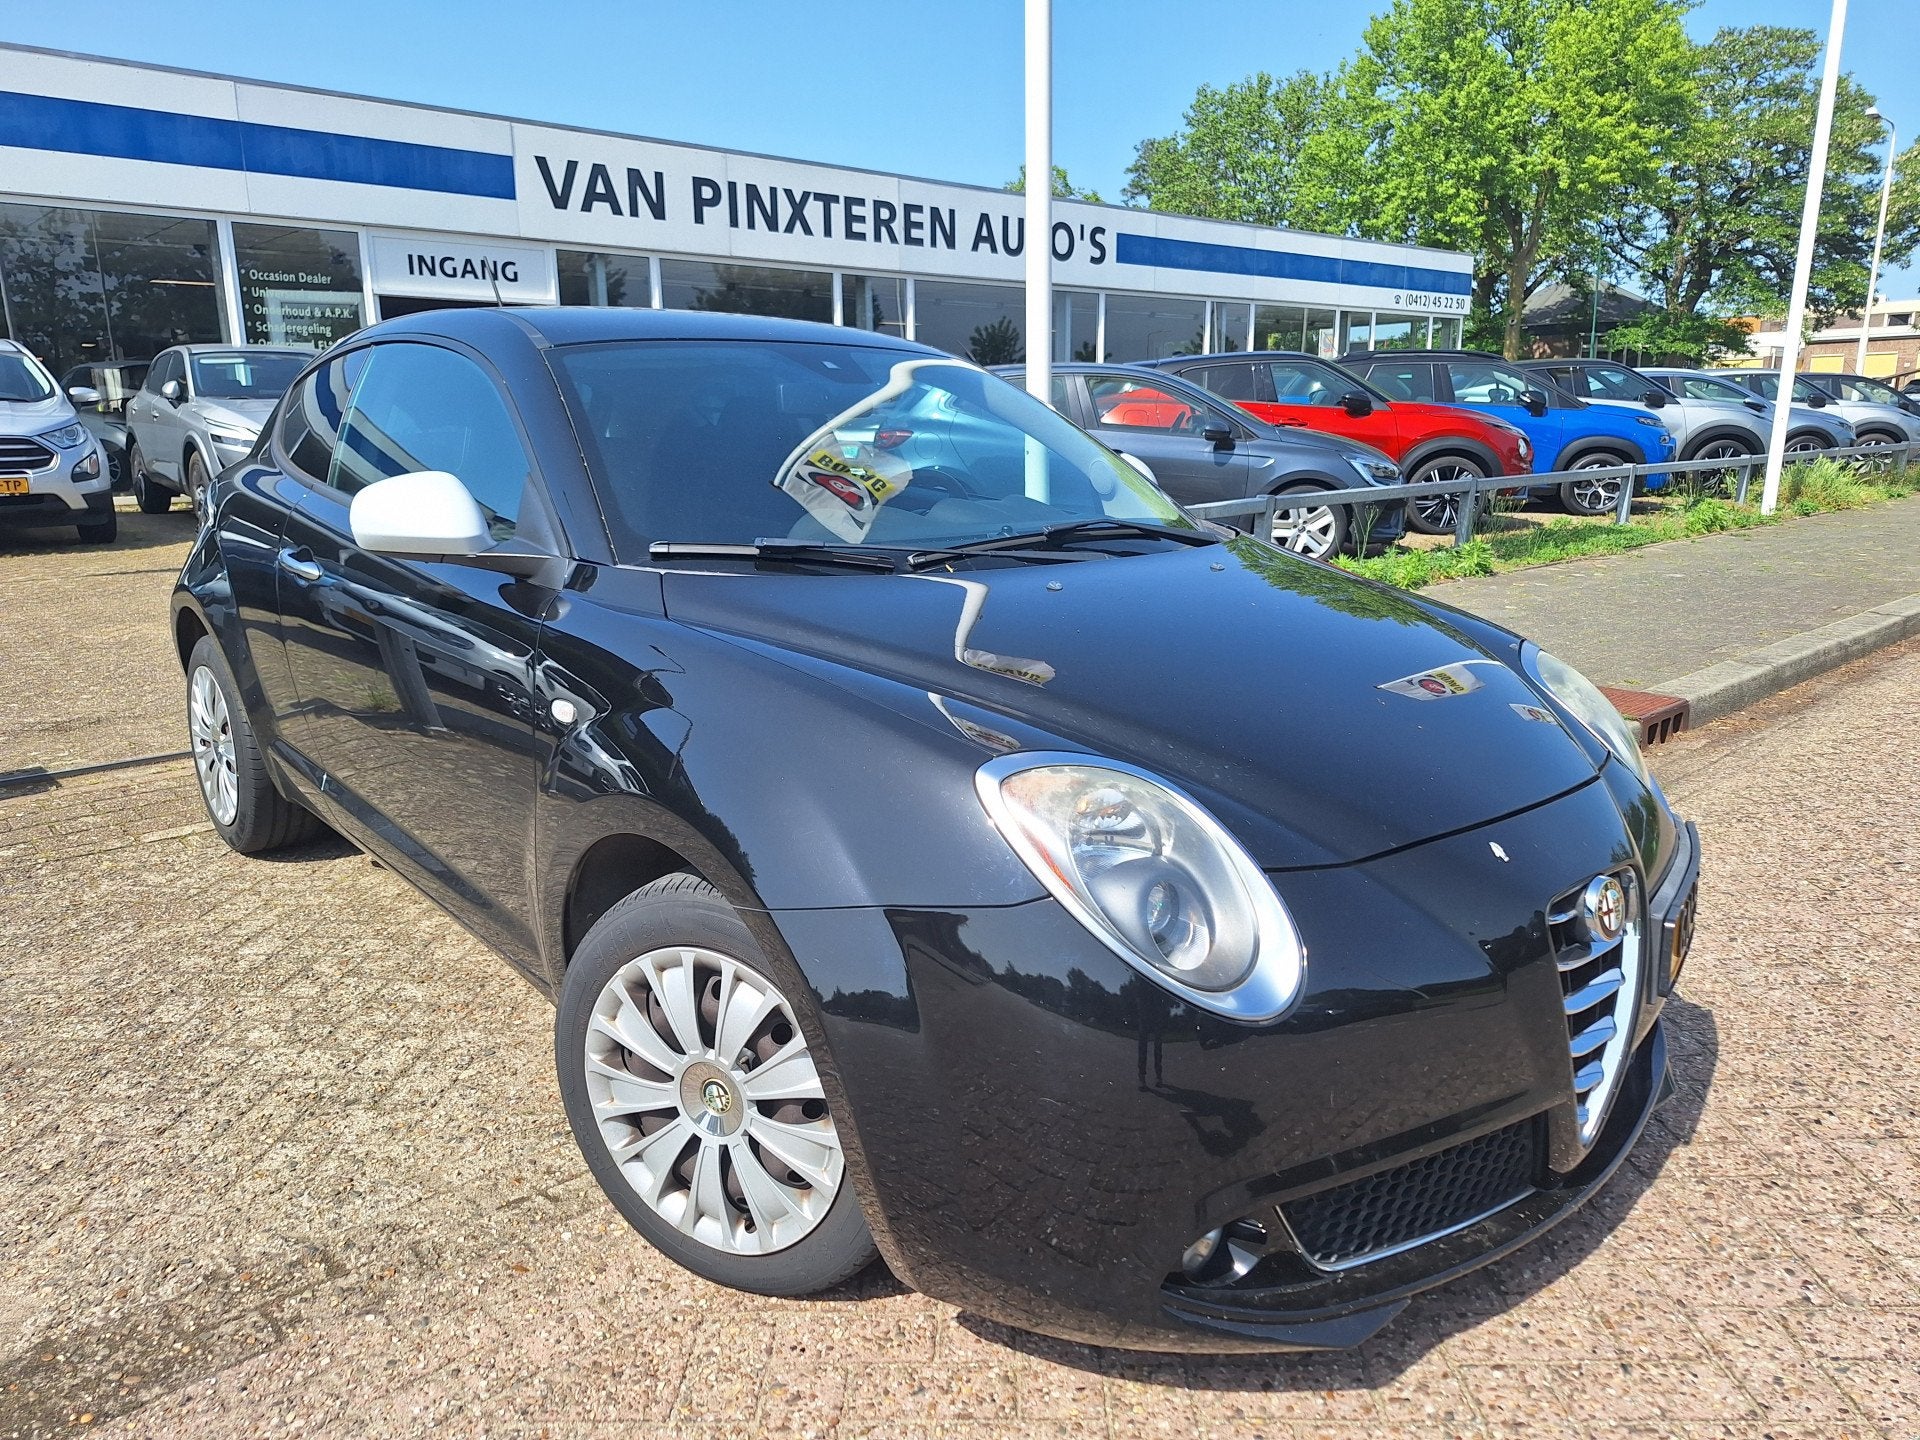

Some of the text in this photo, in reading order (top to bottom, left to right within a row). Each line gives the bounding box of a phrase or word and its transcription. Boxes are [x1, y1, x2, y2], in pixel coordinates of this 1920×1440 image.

[534, 155, 1107, 266] VAN PINXTEREN AUO'S
[407, 253, 519, 283] INGANG
[249, 269, 332, 285] Occasion Dealer
[1405, 293, 1465, 310] (0412) 45 22 50
[314, 307, 322, 317] &
[324, 307, 354, 319] A.P.K.
[255, 321, 332, 338] Schaderegeling
